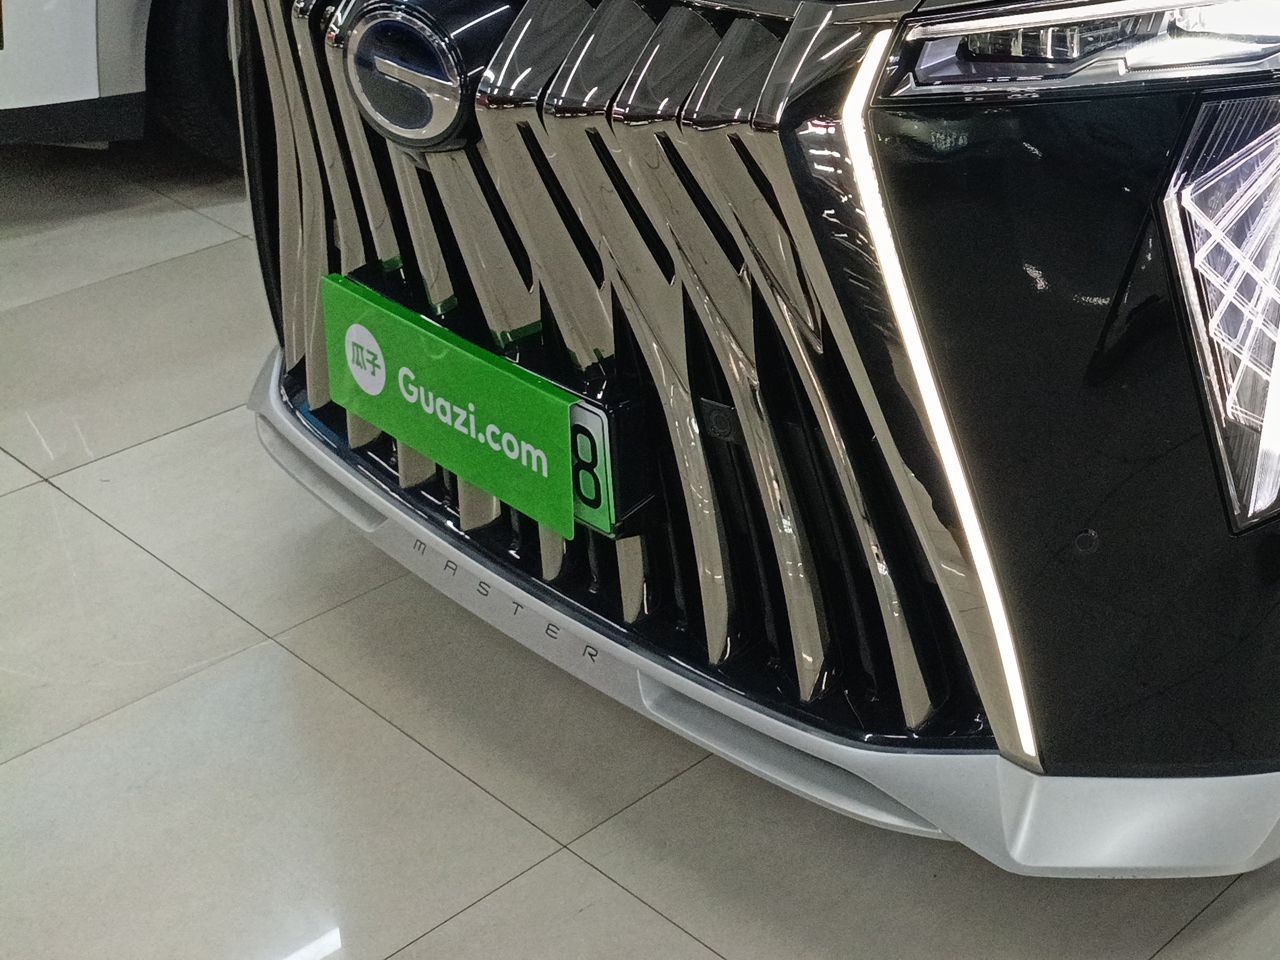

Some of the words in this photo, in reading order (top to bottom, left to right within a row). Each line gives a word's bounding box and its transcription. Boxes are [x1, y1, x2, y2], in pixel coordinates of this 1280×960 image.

[351, 340, 382, 377] 瓜子
[398, 366, 548, 478] Guazi.com
[570, 423, 602, 510] 8
